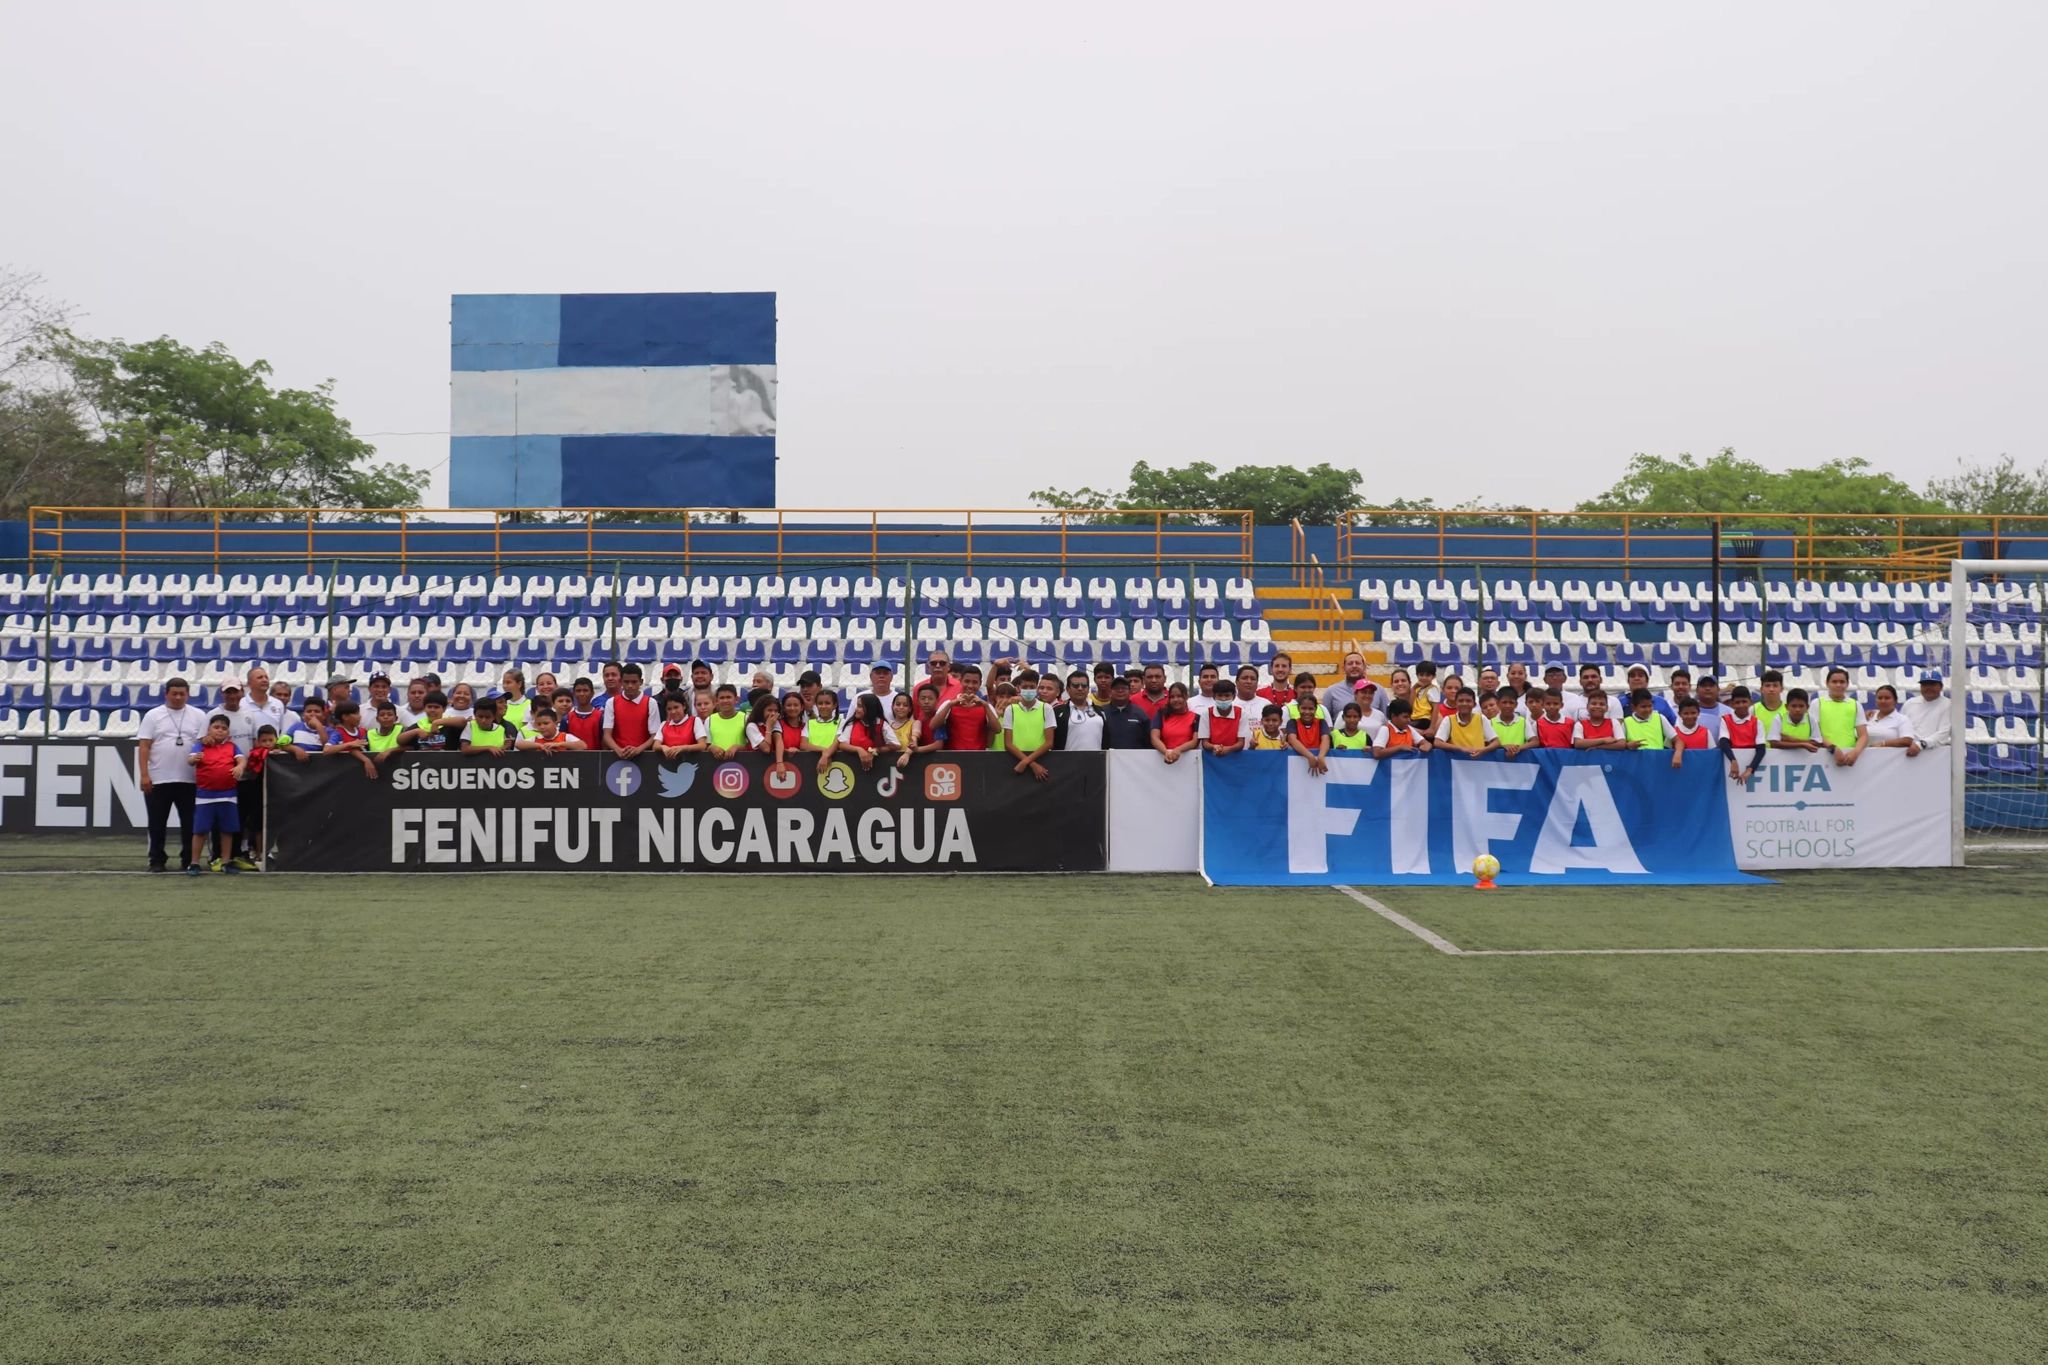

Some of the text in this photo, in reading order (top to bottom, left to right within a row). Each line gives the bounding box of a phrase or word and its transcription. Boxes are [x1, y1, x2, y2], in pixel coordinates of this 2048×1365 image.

[392, 762, 580, 790] SÍGUENOS EN
[1745, 764, 1832, 793] FIFA
[1287, 755, 1652, 875] FIFA
[1746, 818, 1855, 834] FOOTBALL FOR
[391, 807, 977, 864] FENIFUT NICARAGUA
[1746, 838, 1856, 859] SCHOOLS
